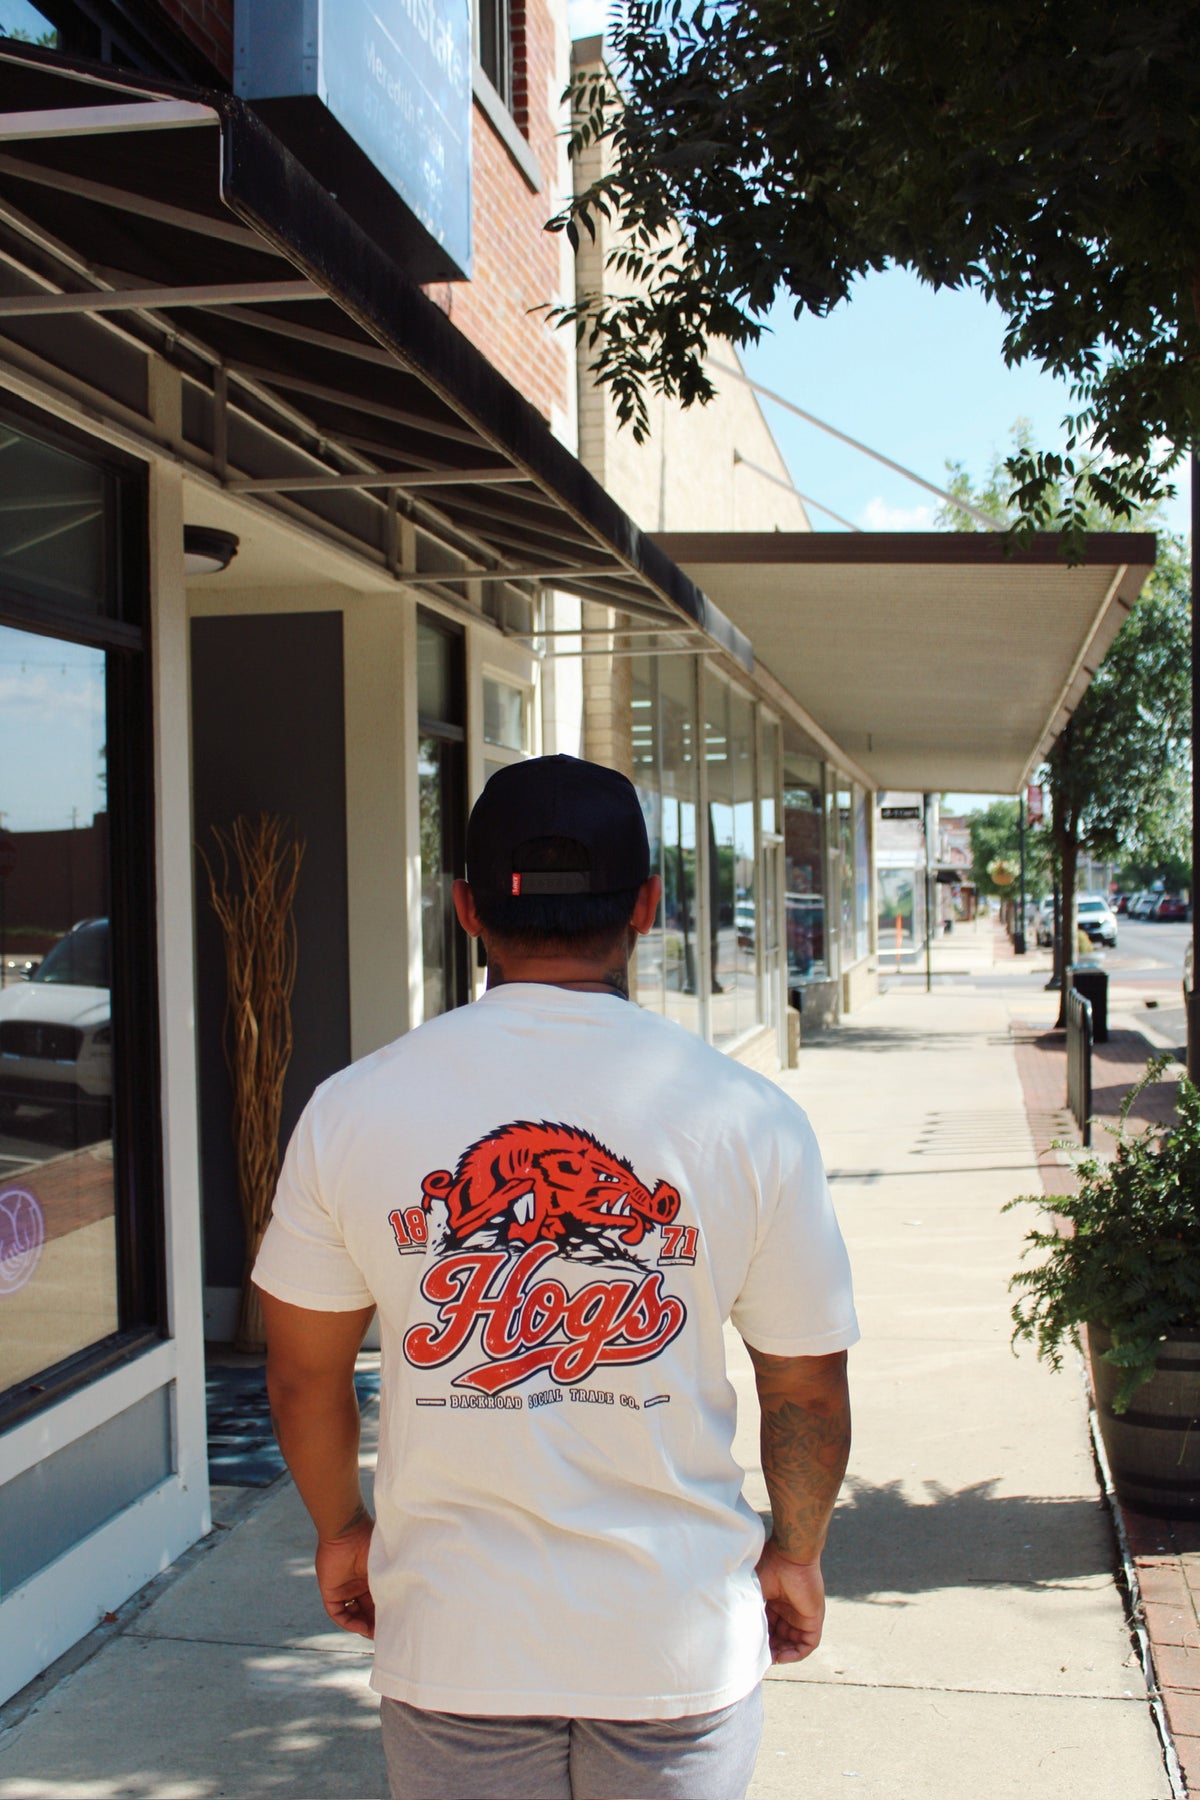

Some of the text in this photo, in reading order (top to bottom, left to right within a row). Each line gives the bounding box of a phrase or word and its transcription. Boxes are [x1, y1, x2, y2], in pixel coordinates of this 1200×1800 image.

[388, 1206, 428, 1246] 18
[660, 1224, 699, 1258] 71
[403, 1241, 688, 1387] Hogs
[450, 1388, 640, 1410] BACKROAD SOCIAL TRADE CO.
